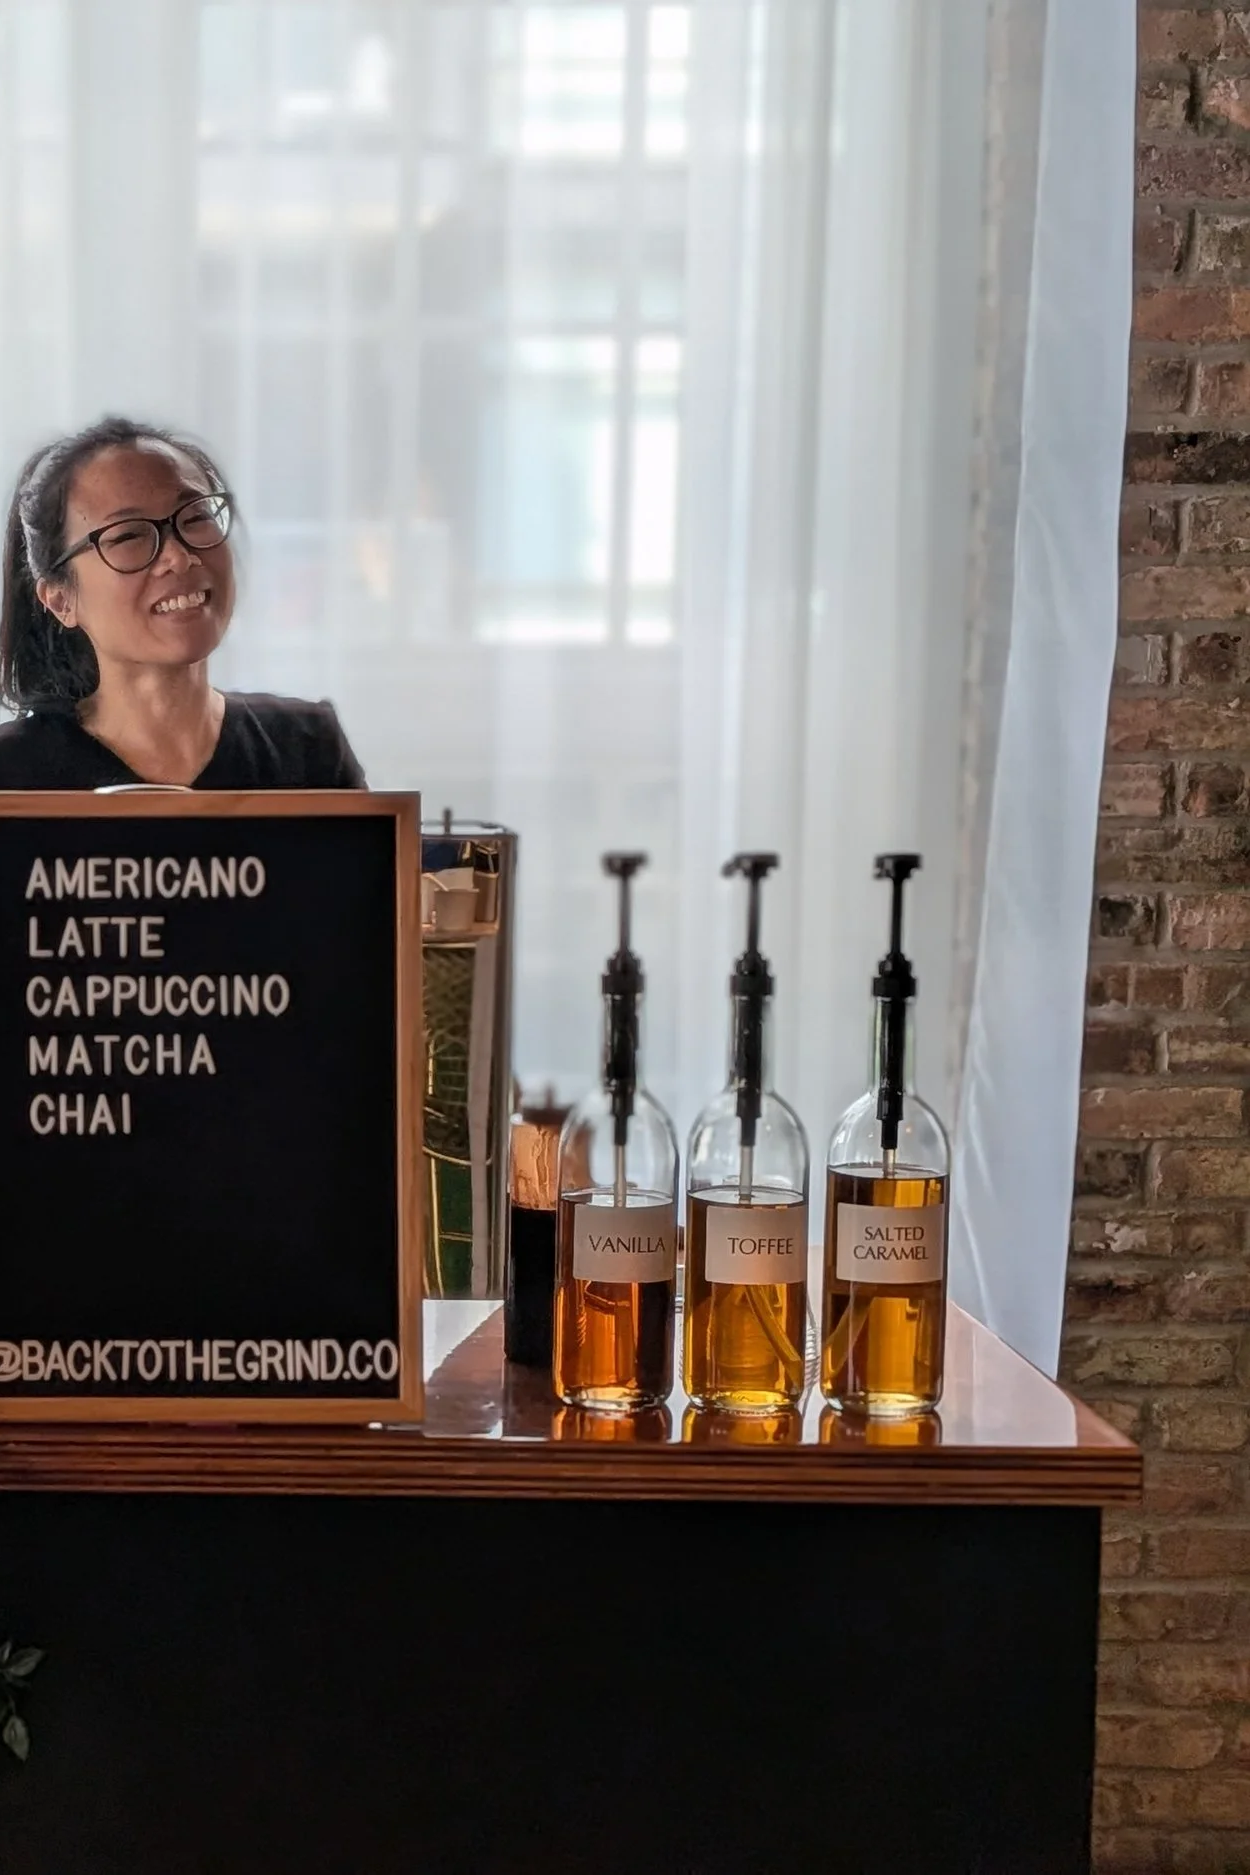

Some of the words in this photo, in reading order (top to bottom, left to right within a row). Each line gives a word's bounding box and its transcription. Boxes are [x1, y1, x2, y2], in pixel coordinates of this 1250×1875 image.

[25, 856, 265, 900] AMERICANO
[28, 916, 166, 959] LATTE
[26, 974, 290, 1018] CAPPUCCINO
[29, 1033, 217, 1076] MATCHA
[29, 1093, 132, 1135] CHAI
[588, 1234, 666, 1253] VANILLA
[727, 1237, 794, 1255] TOFFEE
[853, 1244, 928, 1260] CARAMEL
[864, 1226, 924, 1241] SALTED
